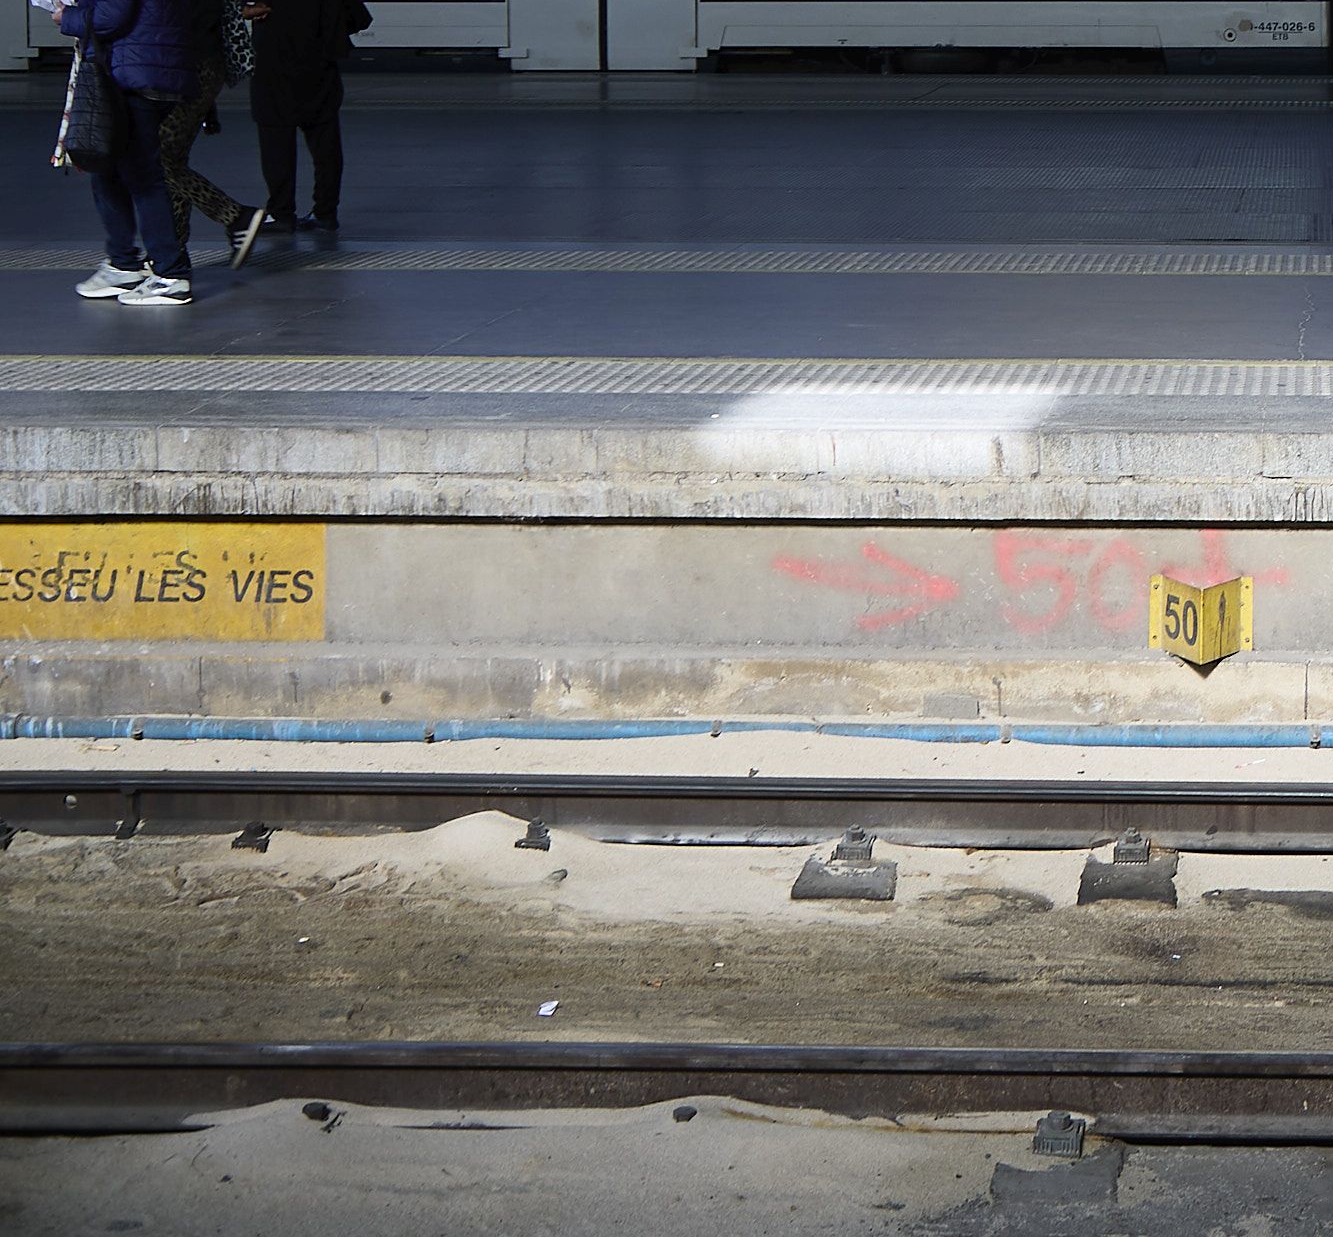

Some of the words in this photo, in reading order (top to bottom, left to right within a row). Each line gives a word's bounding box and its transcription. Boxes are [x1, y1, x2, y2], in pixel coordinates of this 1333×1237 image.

[1250, 21, 1316, 32] -447-026-6
[134, 568, 208, 604] LES
[231, 568, 315, 604] VIES
[1164, 593, 1199, 646] 50
